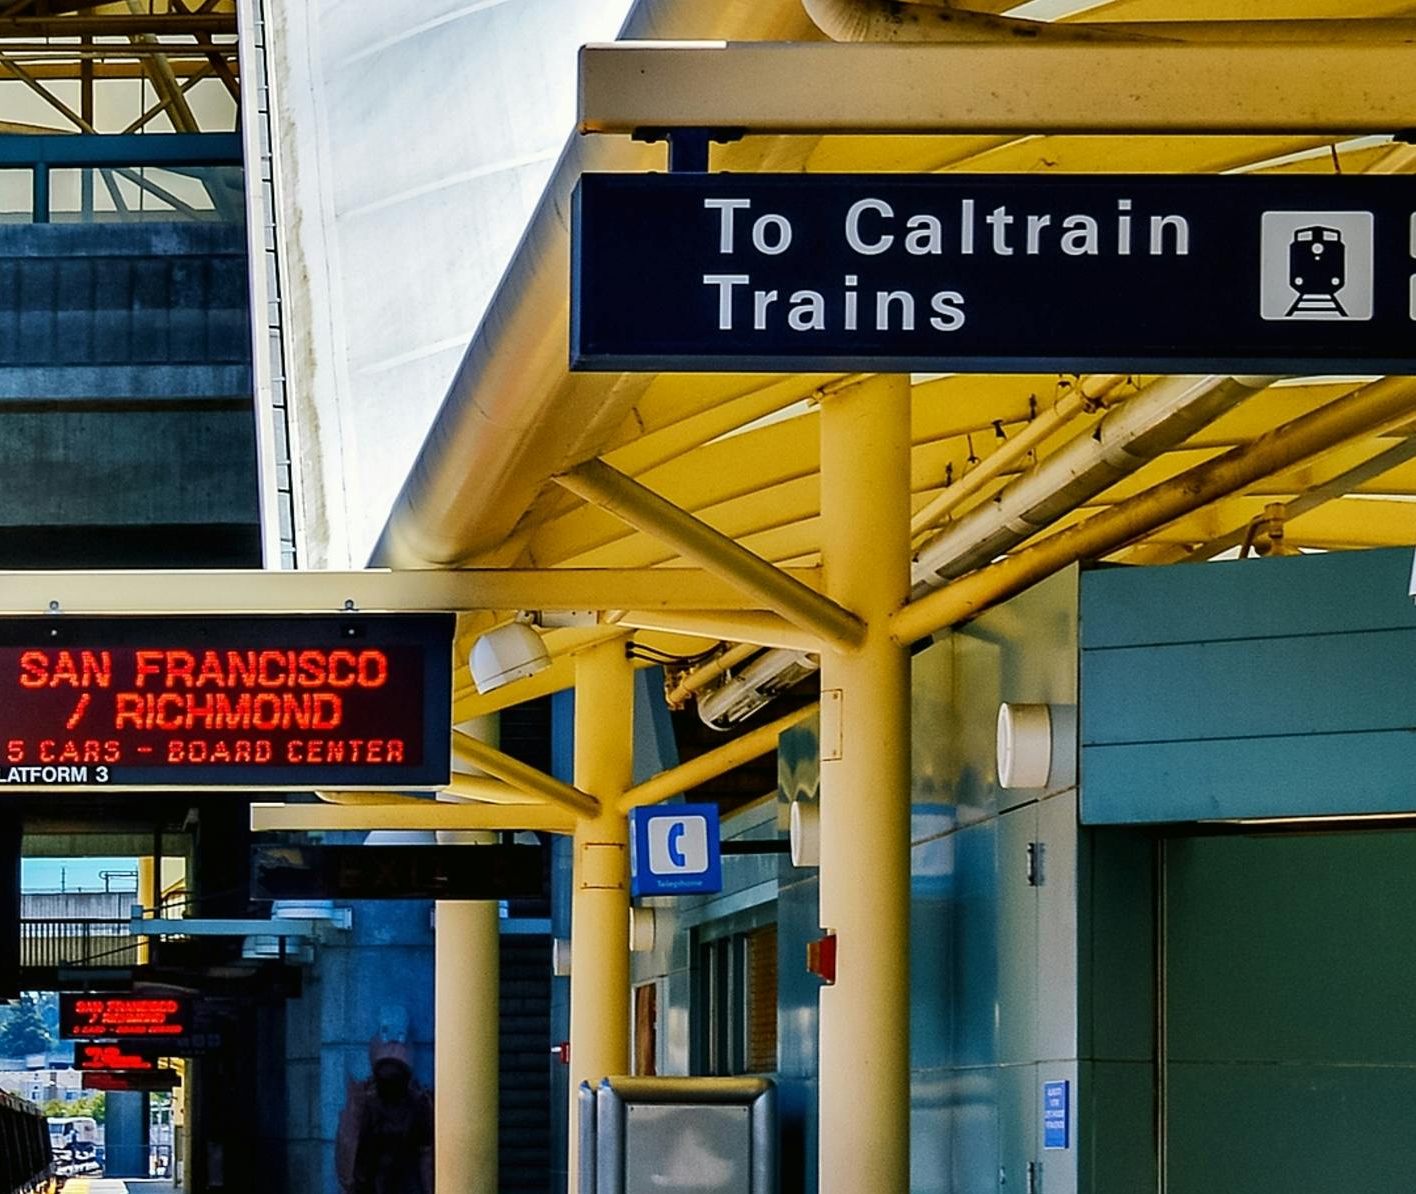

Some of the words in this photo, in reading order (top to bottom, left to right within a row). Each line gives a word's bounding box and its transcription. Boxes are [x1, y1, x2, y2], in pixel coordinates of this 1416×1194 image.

[704, 199, 793, 256] To
[845, 198, 1189, 256] Caltrain
[703, 274, 967, 331] Trains
[19, 650, 112, 688] SAN
[135, 650, 388, 688] FRANCISCO
[66, 693, 90, 731] /
[116, 693, 343, 731] RICHMOND
[7, 740, 25, 763] 5
[39, 740, 120, 763] CARS
[168, 740, 271, 763] BOARD
[287, 740, 404, 763] CENTER
[95, 766, 109, 784] 3
